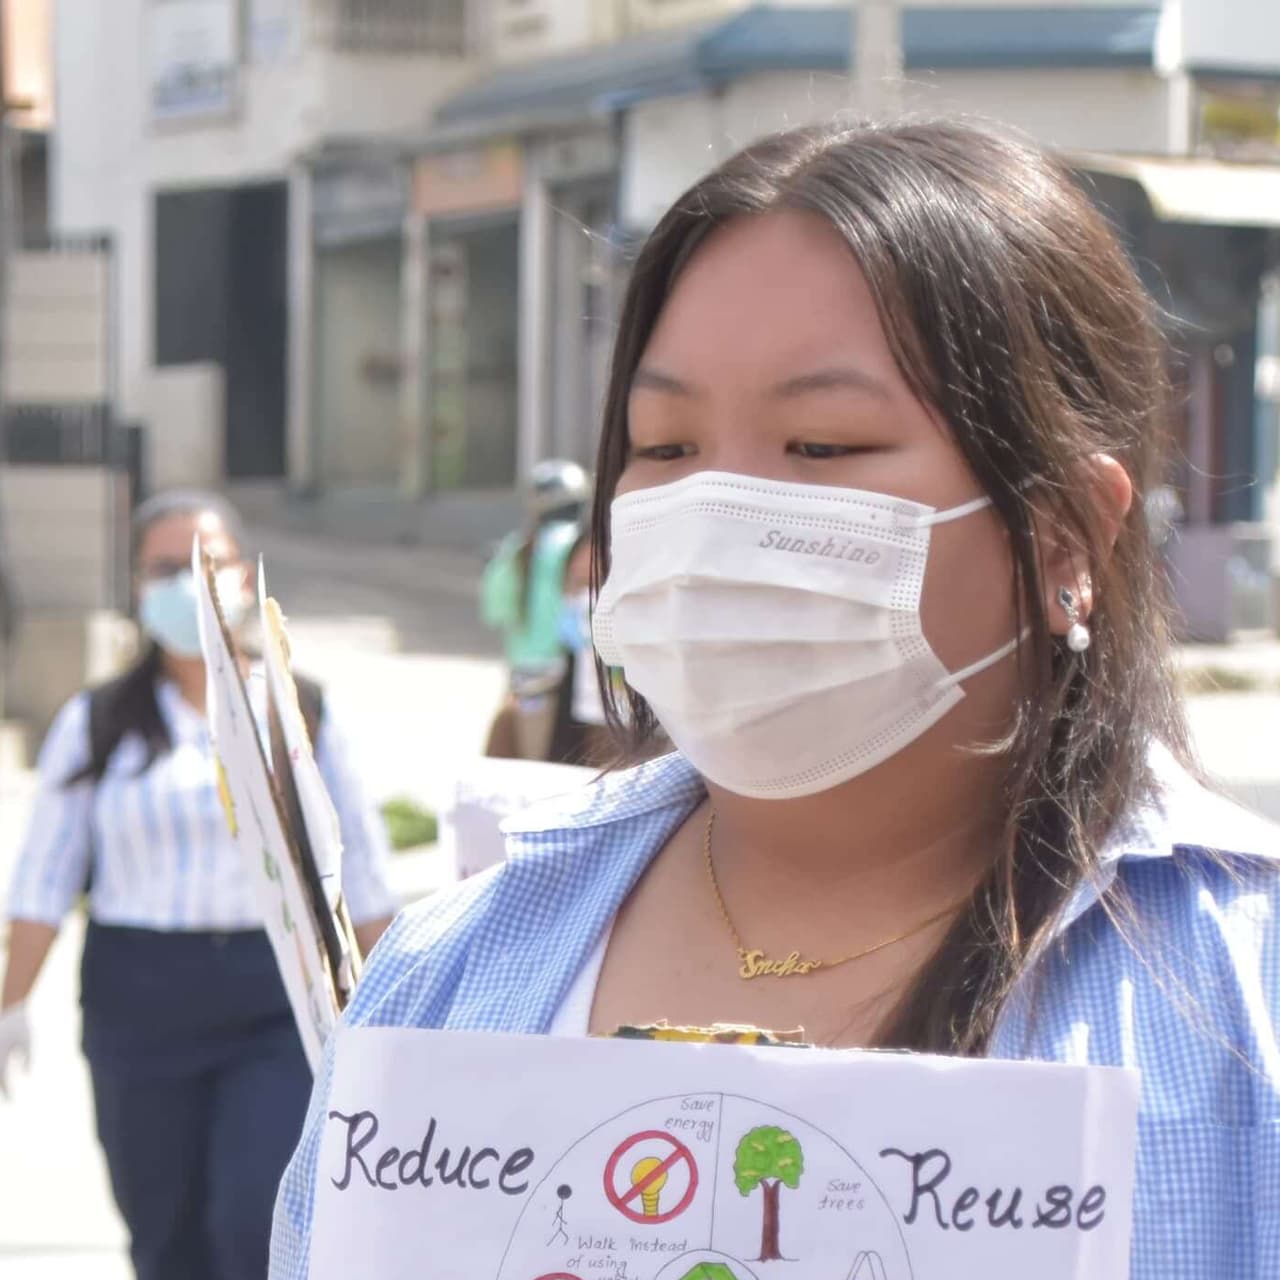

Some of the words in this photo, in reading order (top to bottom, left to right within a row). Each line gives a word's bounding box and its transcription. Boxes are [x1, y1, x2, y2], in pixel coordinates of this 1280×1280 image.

[760, 530, 880, 564] Sunshine
[680, 1098, 714, 1111] Save
[663, 1117, 714, 1142] energy
[329, 1111, 534, 1195] Reduce
[827, 1179, 861, 1193] Save
[879, 1148, 1106, 1231] Reuse
[818, 1196, 864, 1210] trees
[578, 1236, 616, 1250] Walk
[630, 1237, 687, 1251] instead
[567, 1255, 582, 1268] of
[588, 1256, 628, 1279] using
